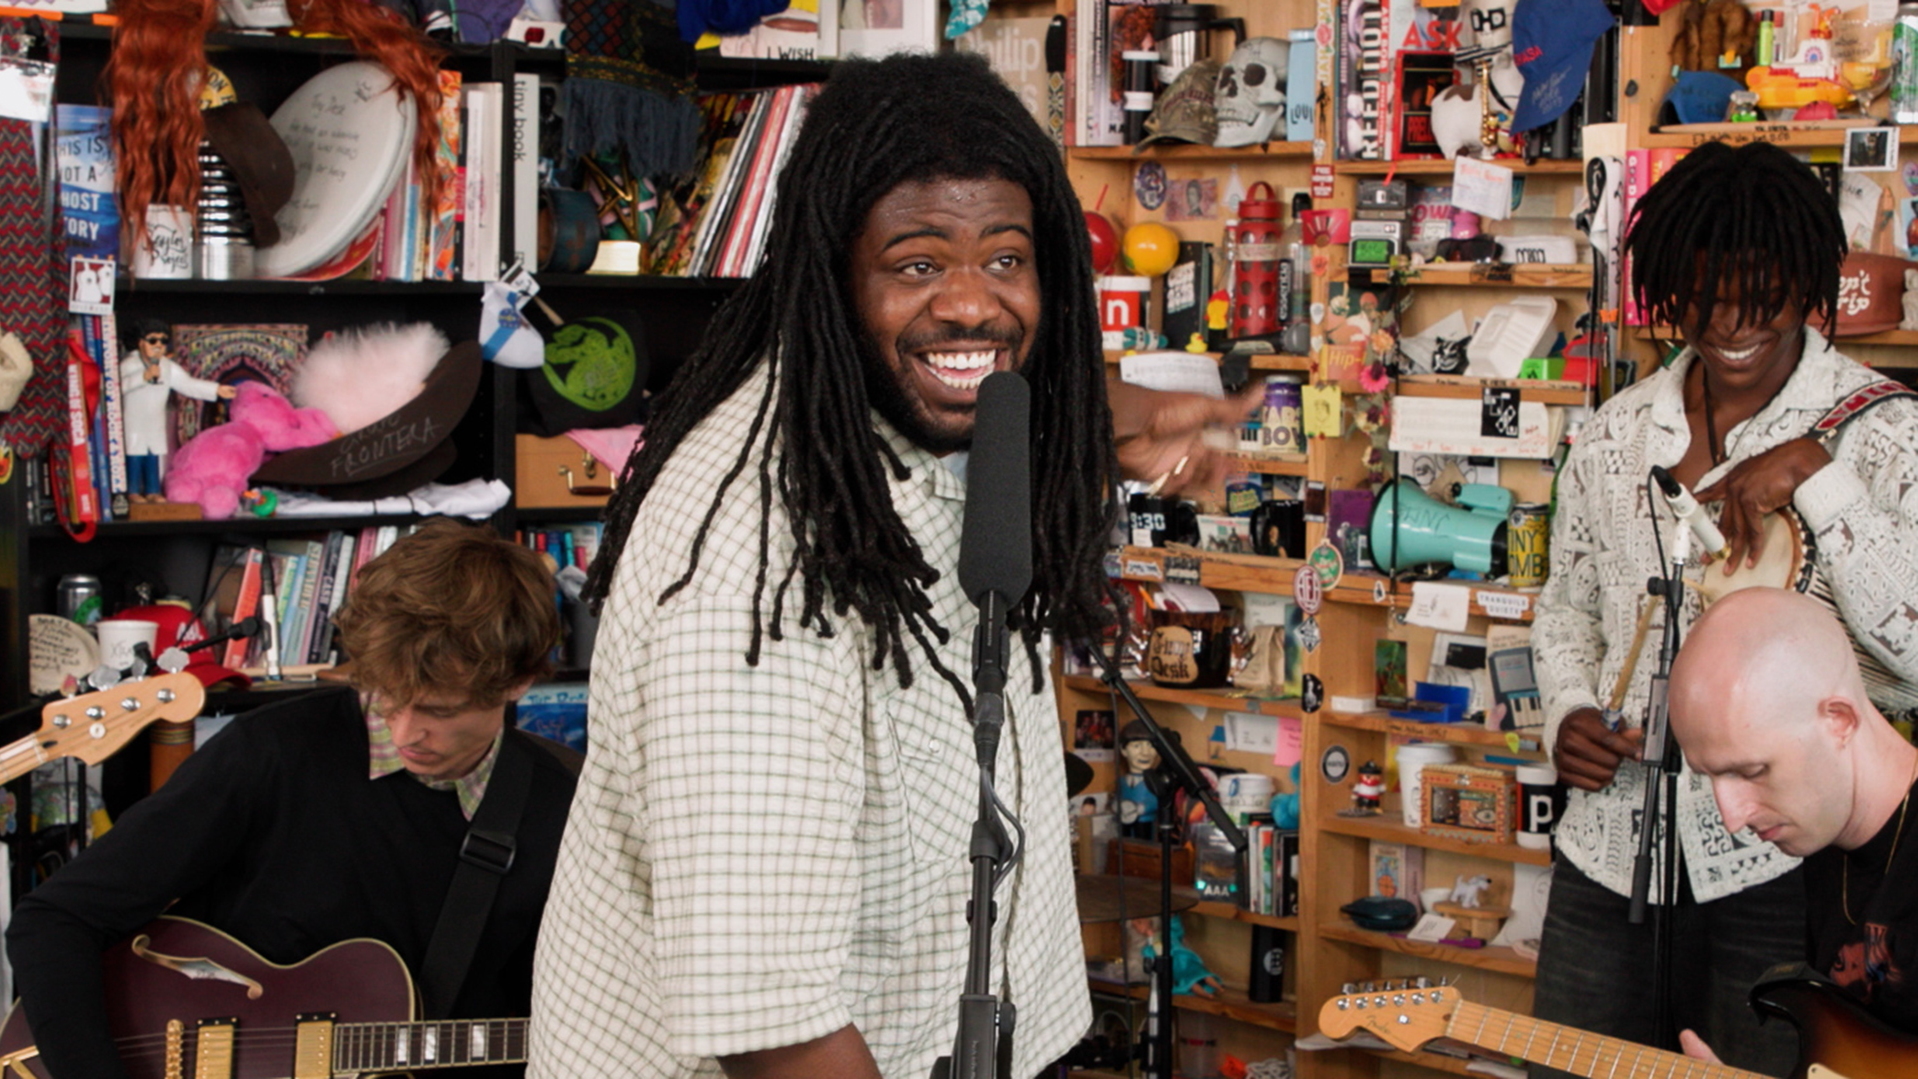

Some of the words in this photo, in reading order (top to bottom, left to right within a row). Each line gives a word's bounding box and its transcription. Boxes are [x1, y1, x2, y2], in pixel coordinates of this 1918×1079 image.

[1402, 20, 1464, 48] ASK
[778, 47, 814, 60] WISH
[965, 28, 1041, 82] hilip
[514, 80, 527, 113] tiny
[87, 137, 104, 153] IS
[514, 117, 527, 163] book
[88, 166, 98, 182] A
[61, 191, 101, 213] HOST
[1839, 269, 1871, 296] on't
[1106, 298, 1130, 326] n
[1837, 292, 1871, 316] rip
[70, 411, 86, 446] SOCA
[1151, 655, 1190, 680] Desk
[1529, 794, 1553, 833] p
